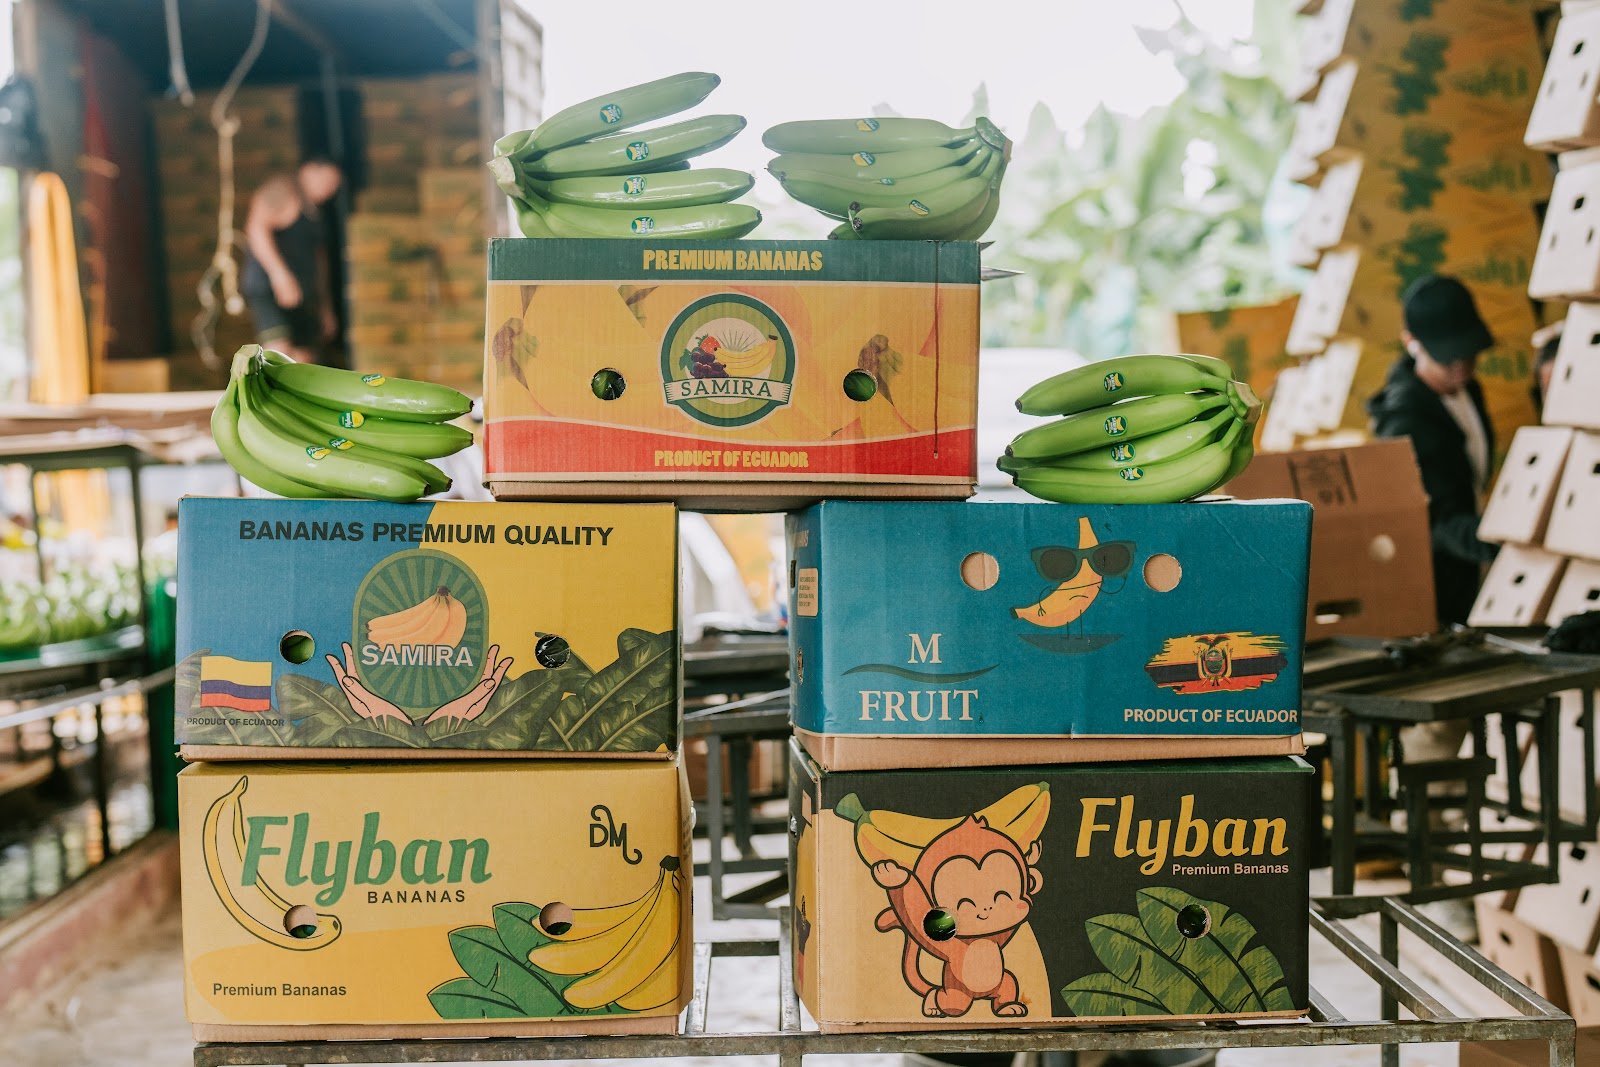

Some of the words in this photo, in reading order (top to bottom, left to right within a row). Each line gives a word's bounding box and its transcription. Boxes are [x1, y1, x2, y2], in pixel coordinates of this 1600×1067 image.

[643, 249, 733, 270] PREMIUM
[736, 250, 823, 271] BANANAS
[681, 379, 772, 397] SAMIRA
[654, 450, 722, 467] PRODUCT
[723, 450, 741, 467] OF
[742, 451, 809, 468] ECUADOR
[239, 520, 364, 541] BANANAS
[373, 522, 495, 544] PREMIUM
[504, 525, 614, 546] QUALITY
[361, 644, 474, 667] SAMIRA
[907, 633, 942, 664] M
[858, 688, 979, 722] FRUIT
[186, 717, 227, 727] PRODUCT
[229, 718, 241, 726] OF
[242, 718, 285, 727] ECUADOR
[1124, 708, 1199, 723] PRODUCT
[1201, 709, 1223, 723] OF
[1226, 709, 1298, 723] ECUADOR
[1075, 794, 1289, 876] Flyban
[241, 811, 493, 907] Flyban
[1172, 863, 1230, 876] Premium
[1233, 862, 1290, 875] Bananas
[367, 889, 466, 904] BANANAS
[213, 982, 277, 996] Premium
[282, 983, 347, 996] Bananas
